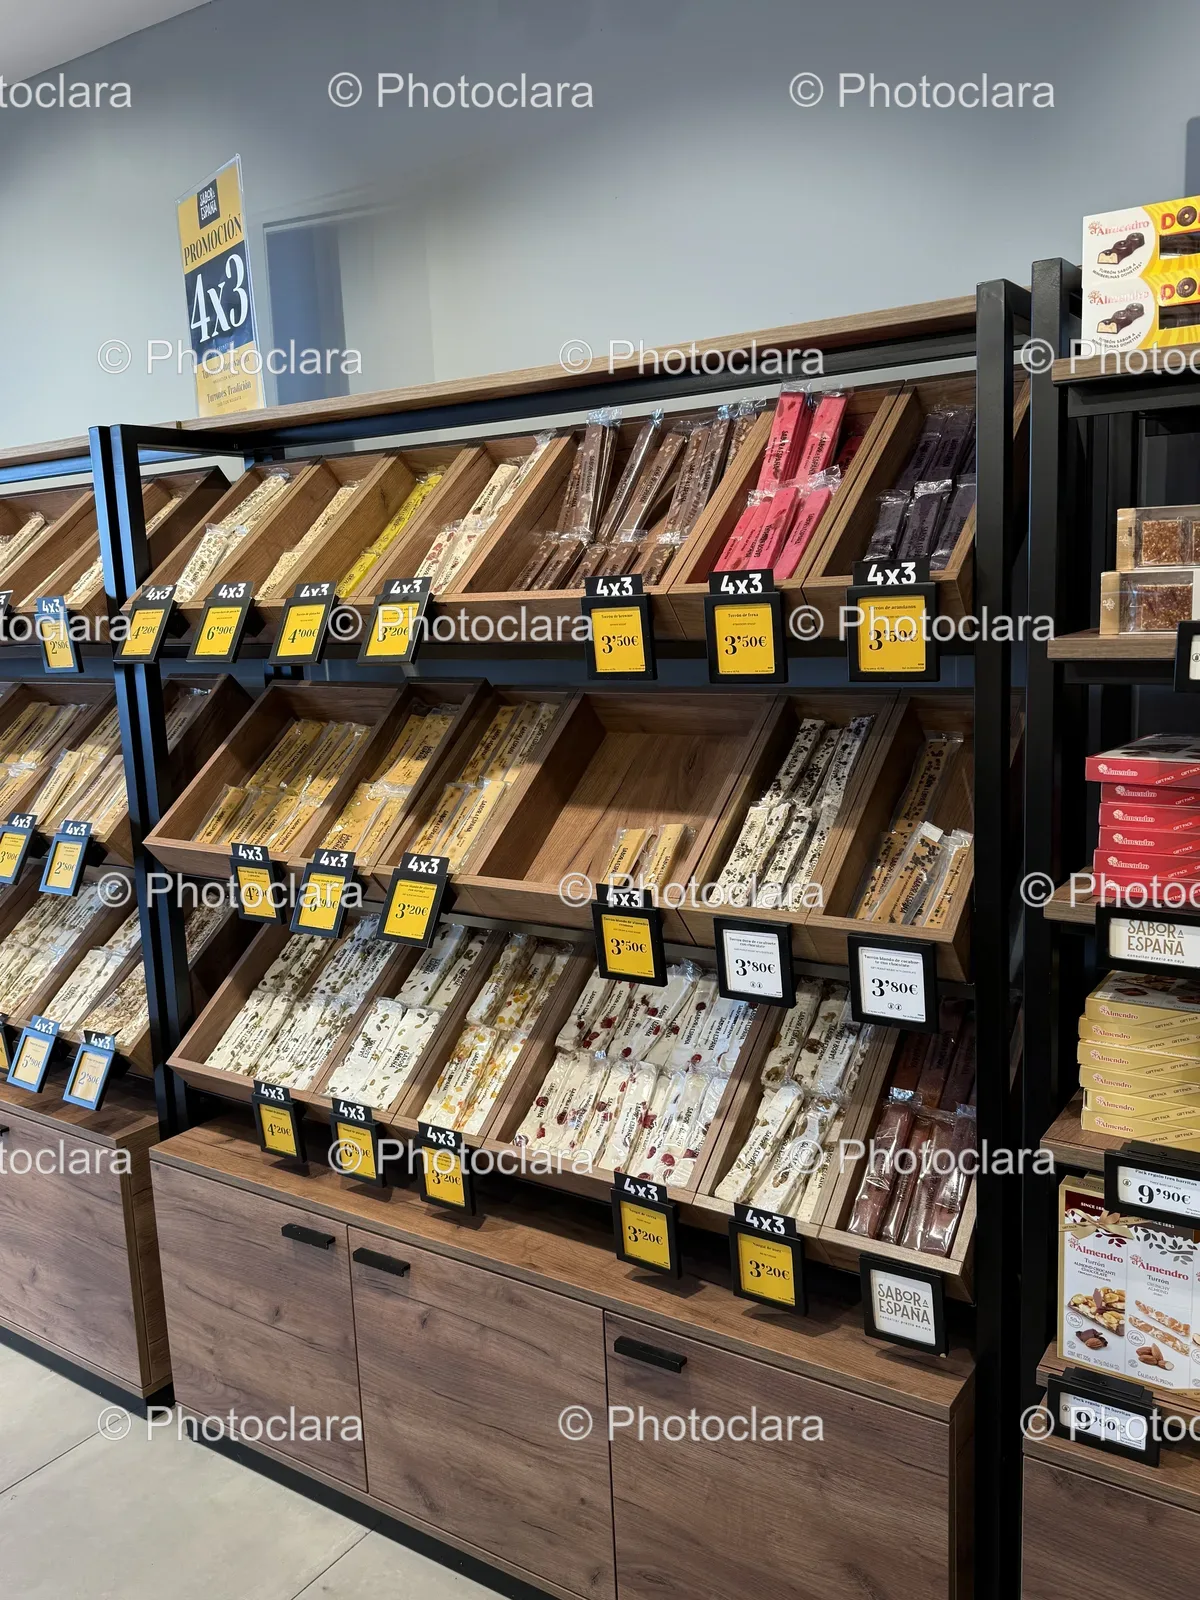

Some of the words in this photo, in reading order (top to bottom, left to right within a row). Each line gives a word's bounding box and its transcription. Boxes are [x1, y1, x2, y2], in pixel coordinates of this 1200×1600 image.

[184, 213, 242, 266] PROMOCIÓN
[190, 254, 248, 342] 4x3
[867, 562, 916, 584] 4x3
[218, 582, 244, 598] 4x3
[390, 580, 422, 594] 4x3
[596, 577, 632, 596] 4x3
[720, 573, 763, 594] 4x3
[146, 588, 173, 600] 4x3
[42, 599, 60, 612] 4x3
[12, 814, 30, 829] 4x3
[66, 822, 87, 836] 4x3
[238, 844, 263, 860] 4x3
[320, 852, 348, 868] 4x3
[408, 856, 440, 874] 4x3
[606, 888, 642, 908] 4x3
[1128, 920, 1176, 938] SABOR
[1128, 936, 1184, 956] ESPAÑA
[34, 1018, 54, 1035] 4x3
[90, 1033, 112, 1050] 4x3
[260, 1083, 285, 1101] 4x3
[340, 1102, 366, 1122] 4x3
[426, 1126, 456, 1147] 4x3
[624, 1178, 658, 1201] 4x3
[746, 1209, 786, 1235] 4x3
[1076, 1246, 1124, 1263] Almendro
[1138, 1262, 1189, 1280] Almendro
[878, 1284, 921, 1308] SABOR
[880, 1298, 931, 1325] ESPAÑA
